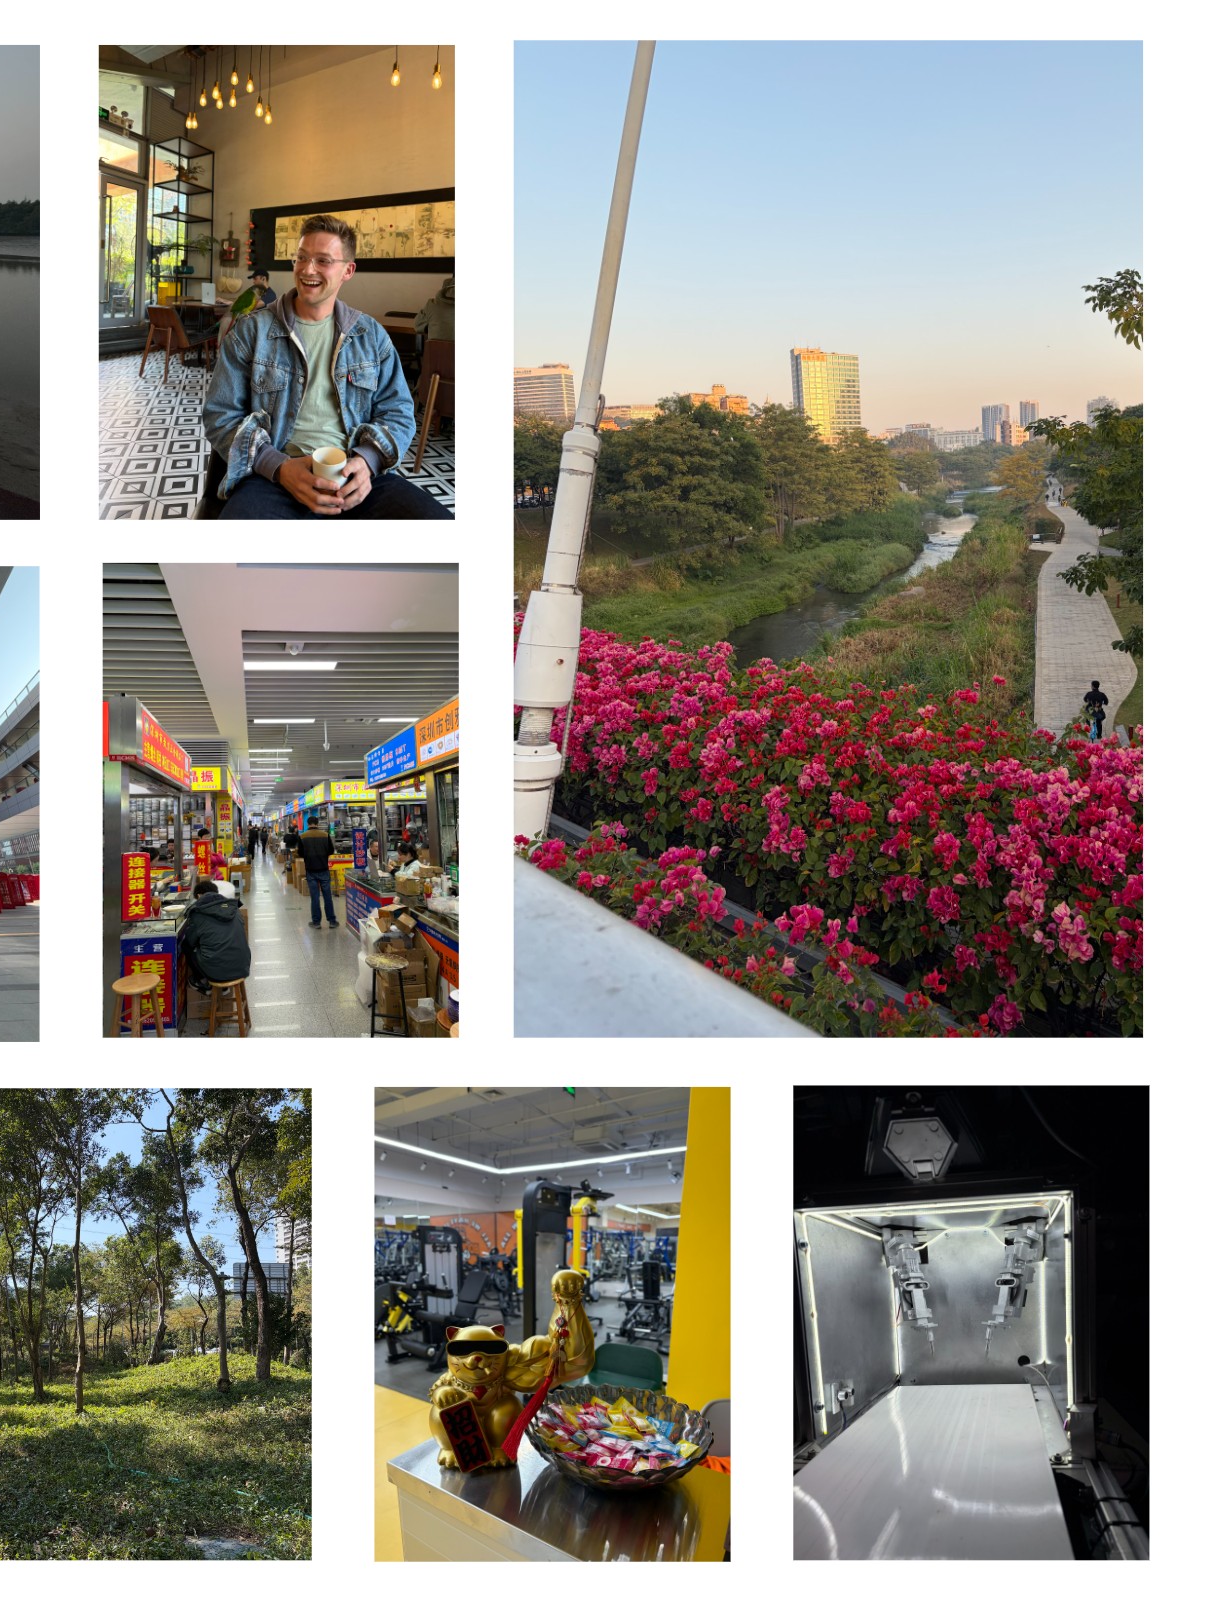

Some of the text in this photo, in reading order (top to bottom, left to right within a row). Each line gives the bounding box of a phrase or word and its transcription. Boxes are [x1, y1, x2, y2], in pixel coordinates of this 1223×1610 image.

[127, 856, 147, 917] 连接器开关
